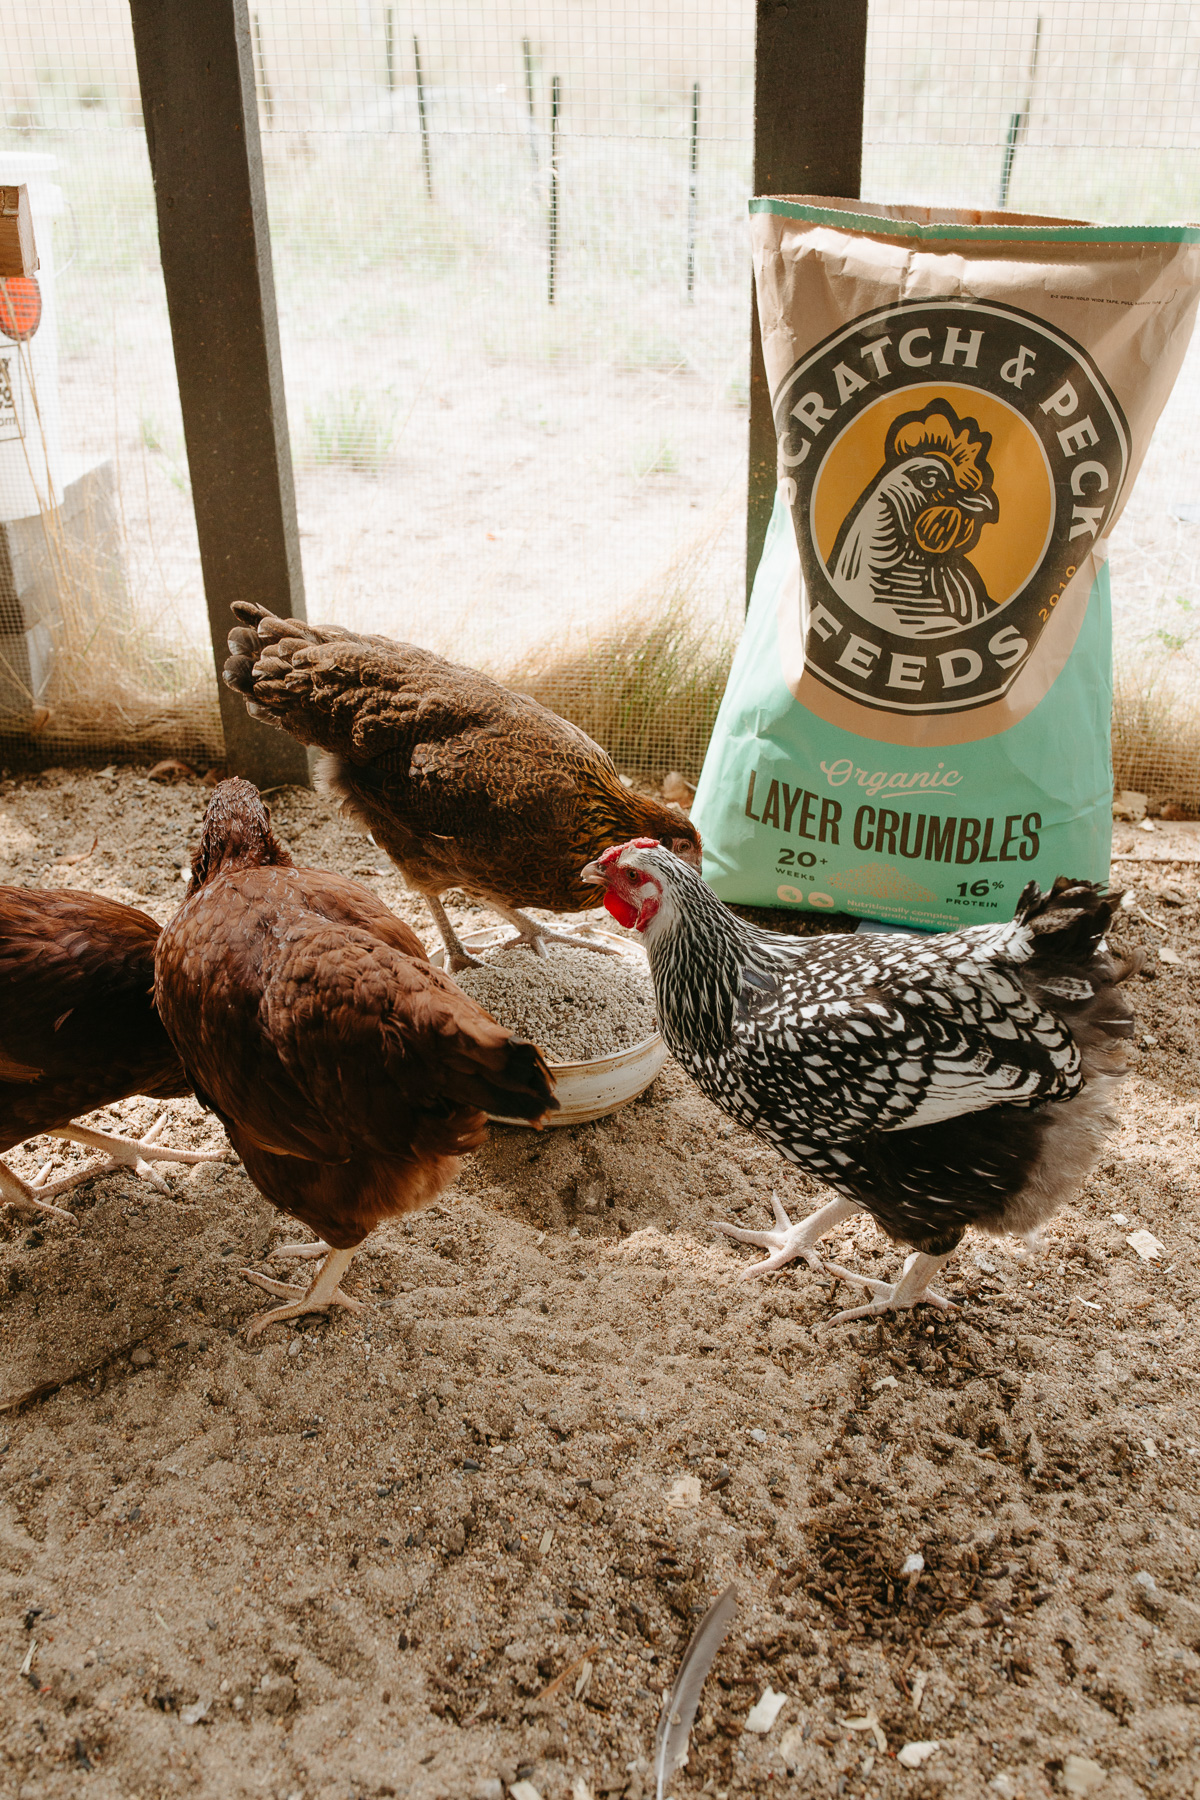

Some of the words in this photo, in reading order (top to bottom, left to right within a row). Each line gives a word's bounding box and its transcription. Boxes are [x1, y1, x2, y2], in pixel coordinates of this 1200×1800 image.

[1000, 345, 1037, 390] &
[1039, 380, 1110, 542] PECK
[1038, 564, 1077, 622] 2010
[804, 601, 1029, 691] FEEDS
[820, 758, 963, 798] Organic
[745, 769, 842, 846] LAYER
[853, 804, 1042, 865] CRUMBLES
[775, 867, 815, 881] WEEKS
[847, 899, 910, 915] Nutritionally
[911, 910, 960, 921] complete
[909, 915, 935, 925] layer
[945, 898, 998, 908] PROTEIN
